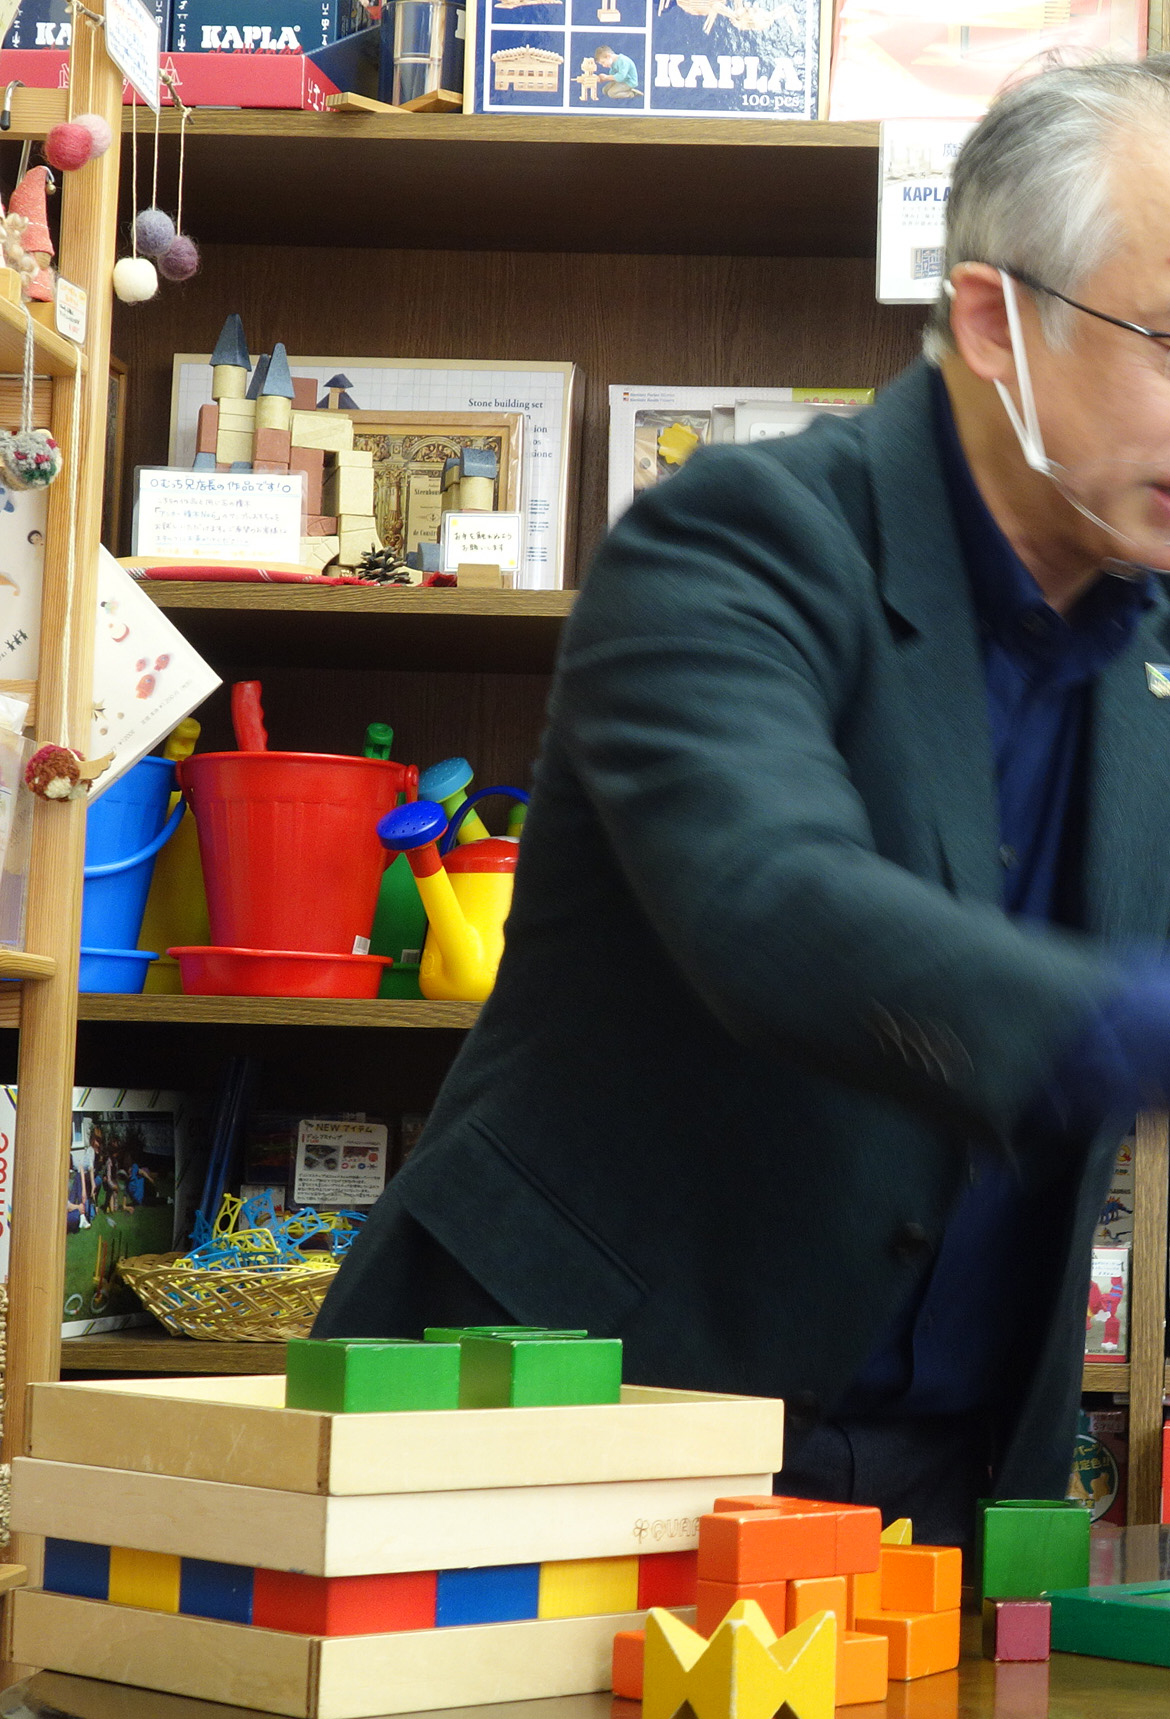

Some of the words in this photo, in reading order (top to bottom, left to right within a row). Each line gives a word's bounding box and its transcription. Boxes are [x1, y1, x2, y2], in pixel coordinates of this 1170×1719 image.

[655, 54, 803, 93] KAPLA
[742, 94, 771, 107] 100
[774, 96, 800, 110] pcs
[468, 398, 493, 408] Stone
[494, 399, 530, 411] building
[316, 1123, 340, 1132] NEW
[343, 1124, 373, 1133] アイテム
